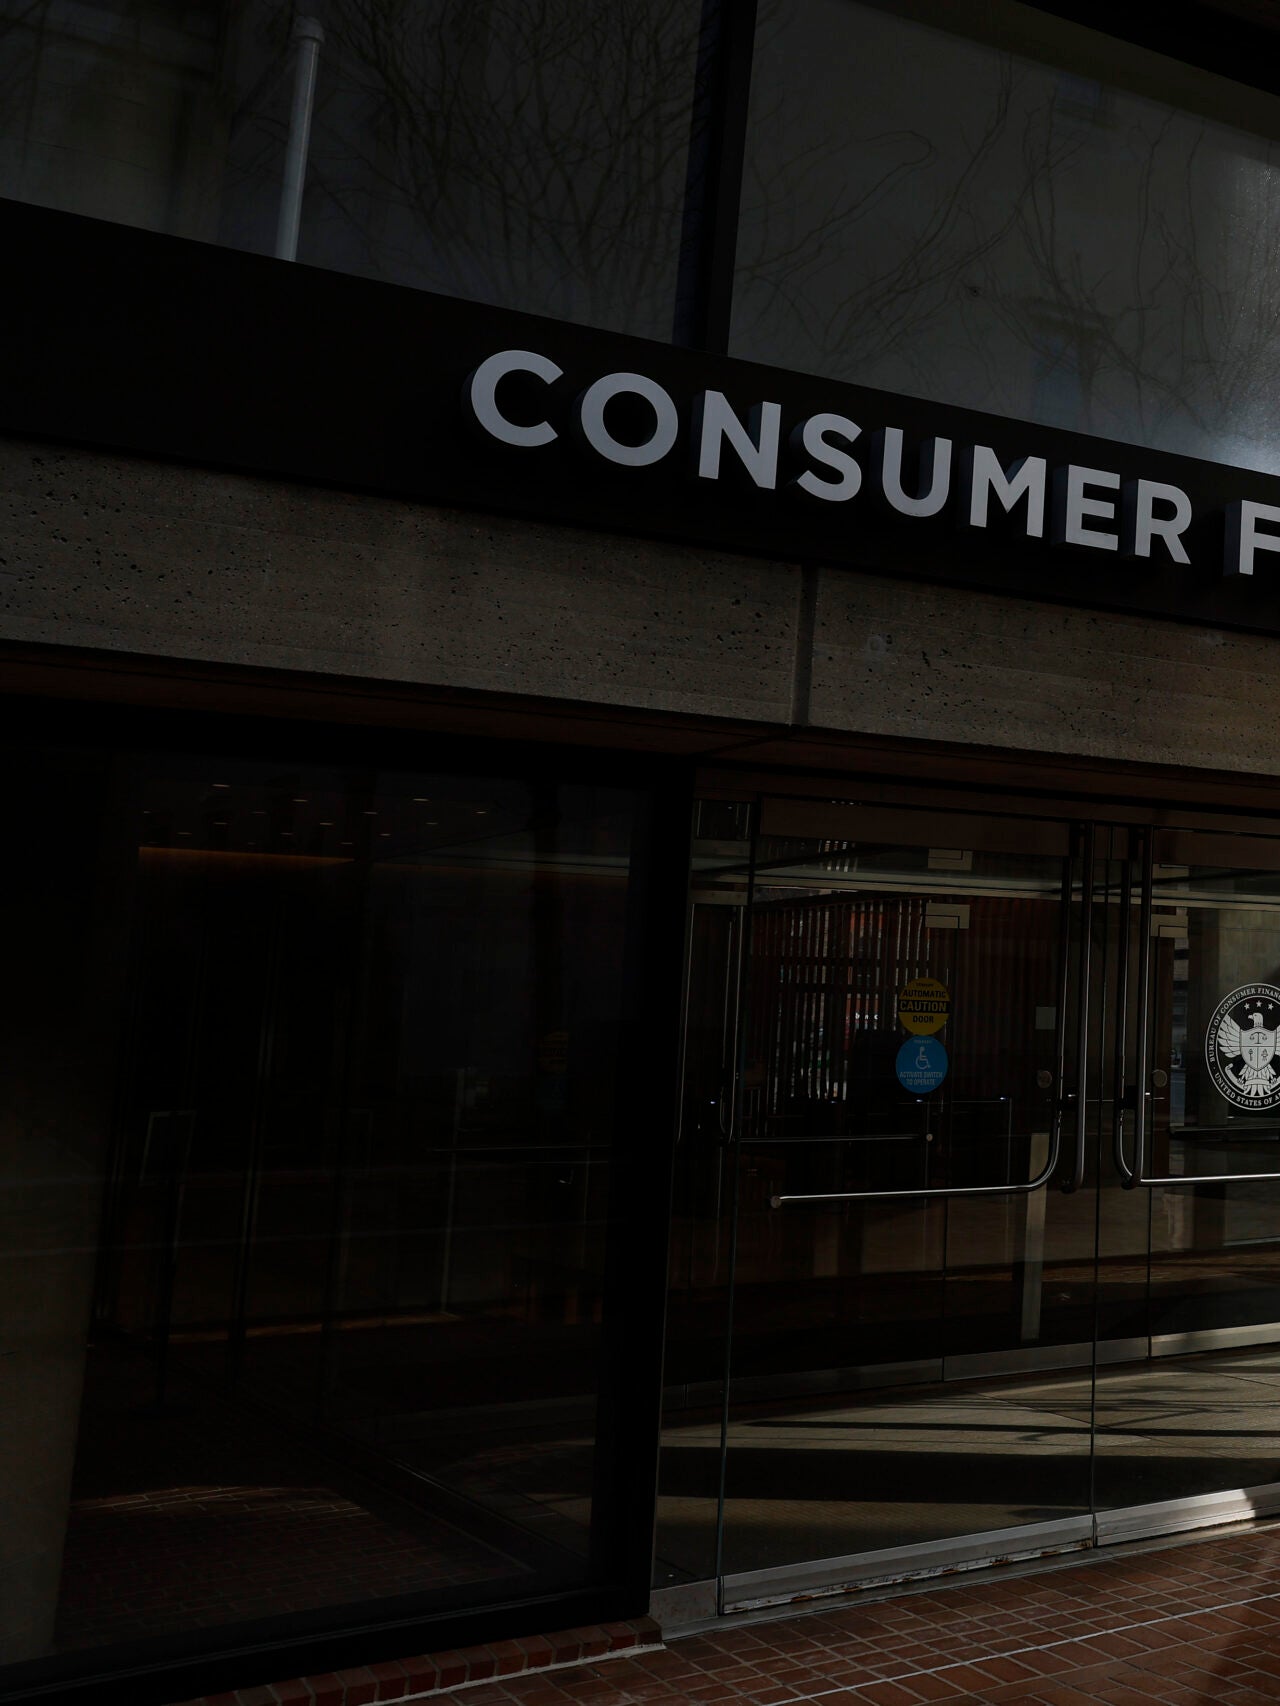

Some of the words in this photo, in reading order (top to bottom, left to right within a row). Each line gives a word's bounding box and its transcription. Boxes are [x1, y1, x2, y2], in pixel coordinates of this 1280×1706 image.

[469, 349, 1192, 564] CONSUMER
[903, 990, 946, 998] AUTOMATIC
[899, 1001, 947, 1012] CAUTION
[913, 1015, 934, 1023] DOOR
[1207, 1029, 1216, 1063] BUREAU
[1213, 1016, 1220, 1025] OF
[1220, 988, 1256, 1015] CONSUMER
[1214, 1072, 1236, 1099] UNITED
[1236, 1096, 1262, 1106] STATES
[1263, 1097, 1273, 1106] OF
